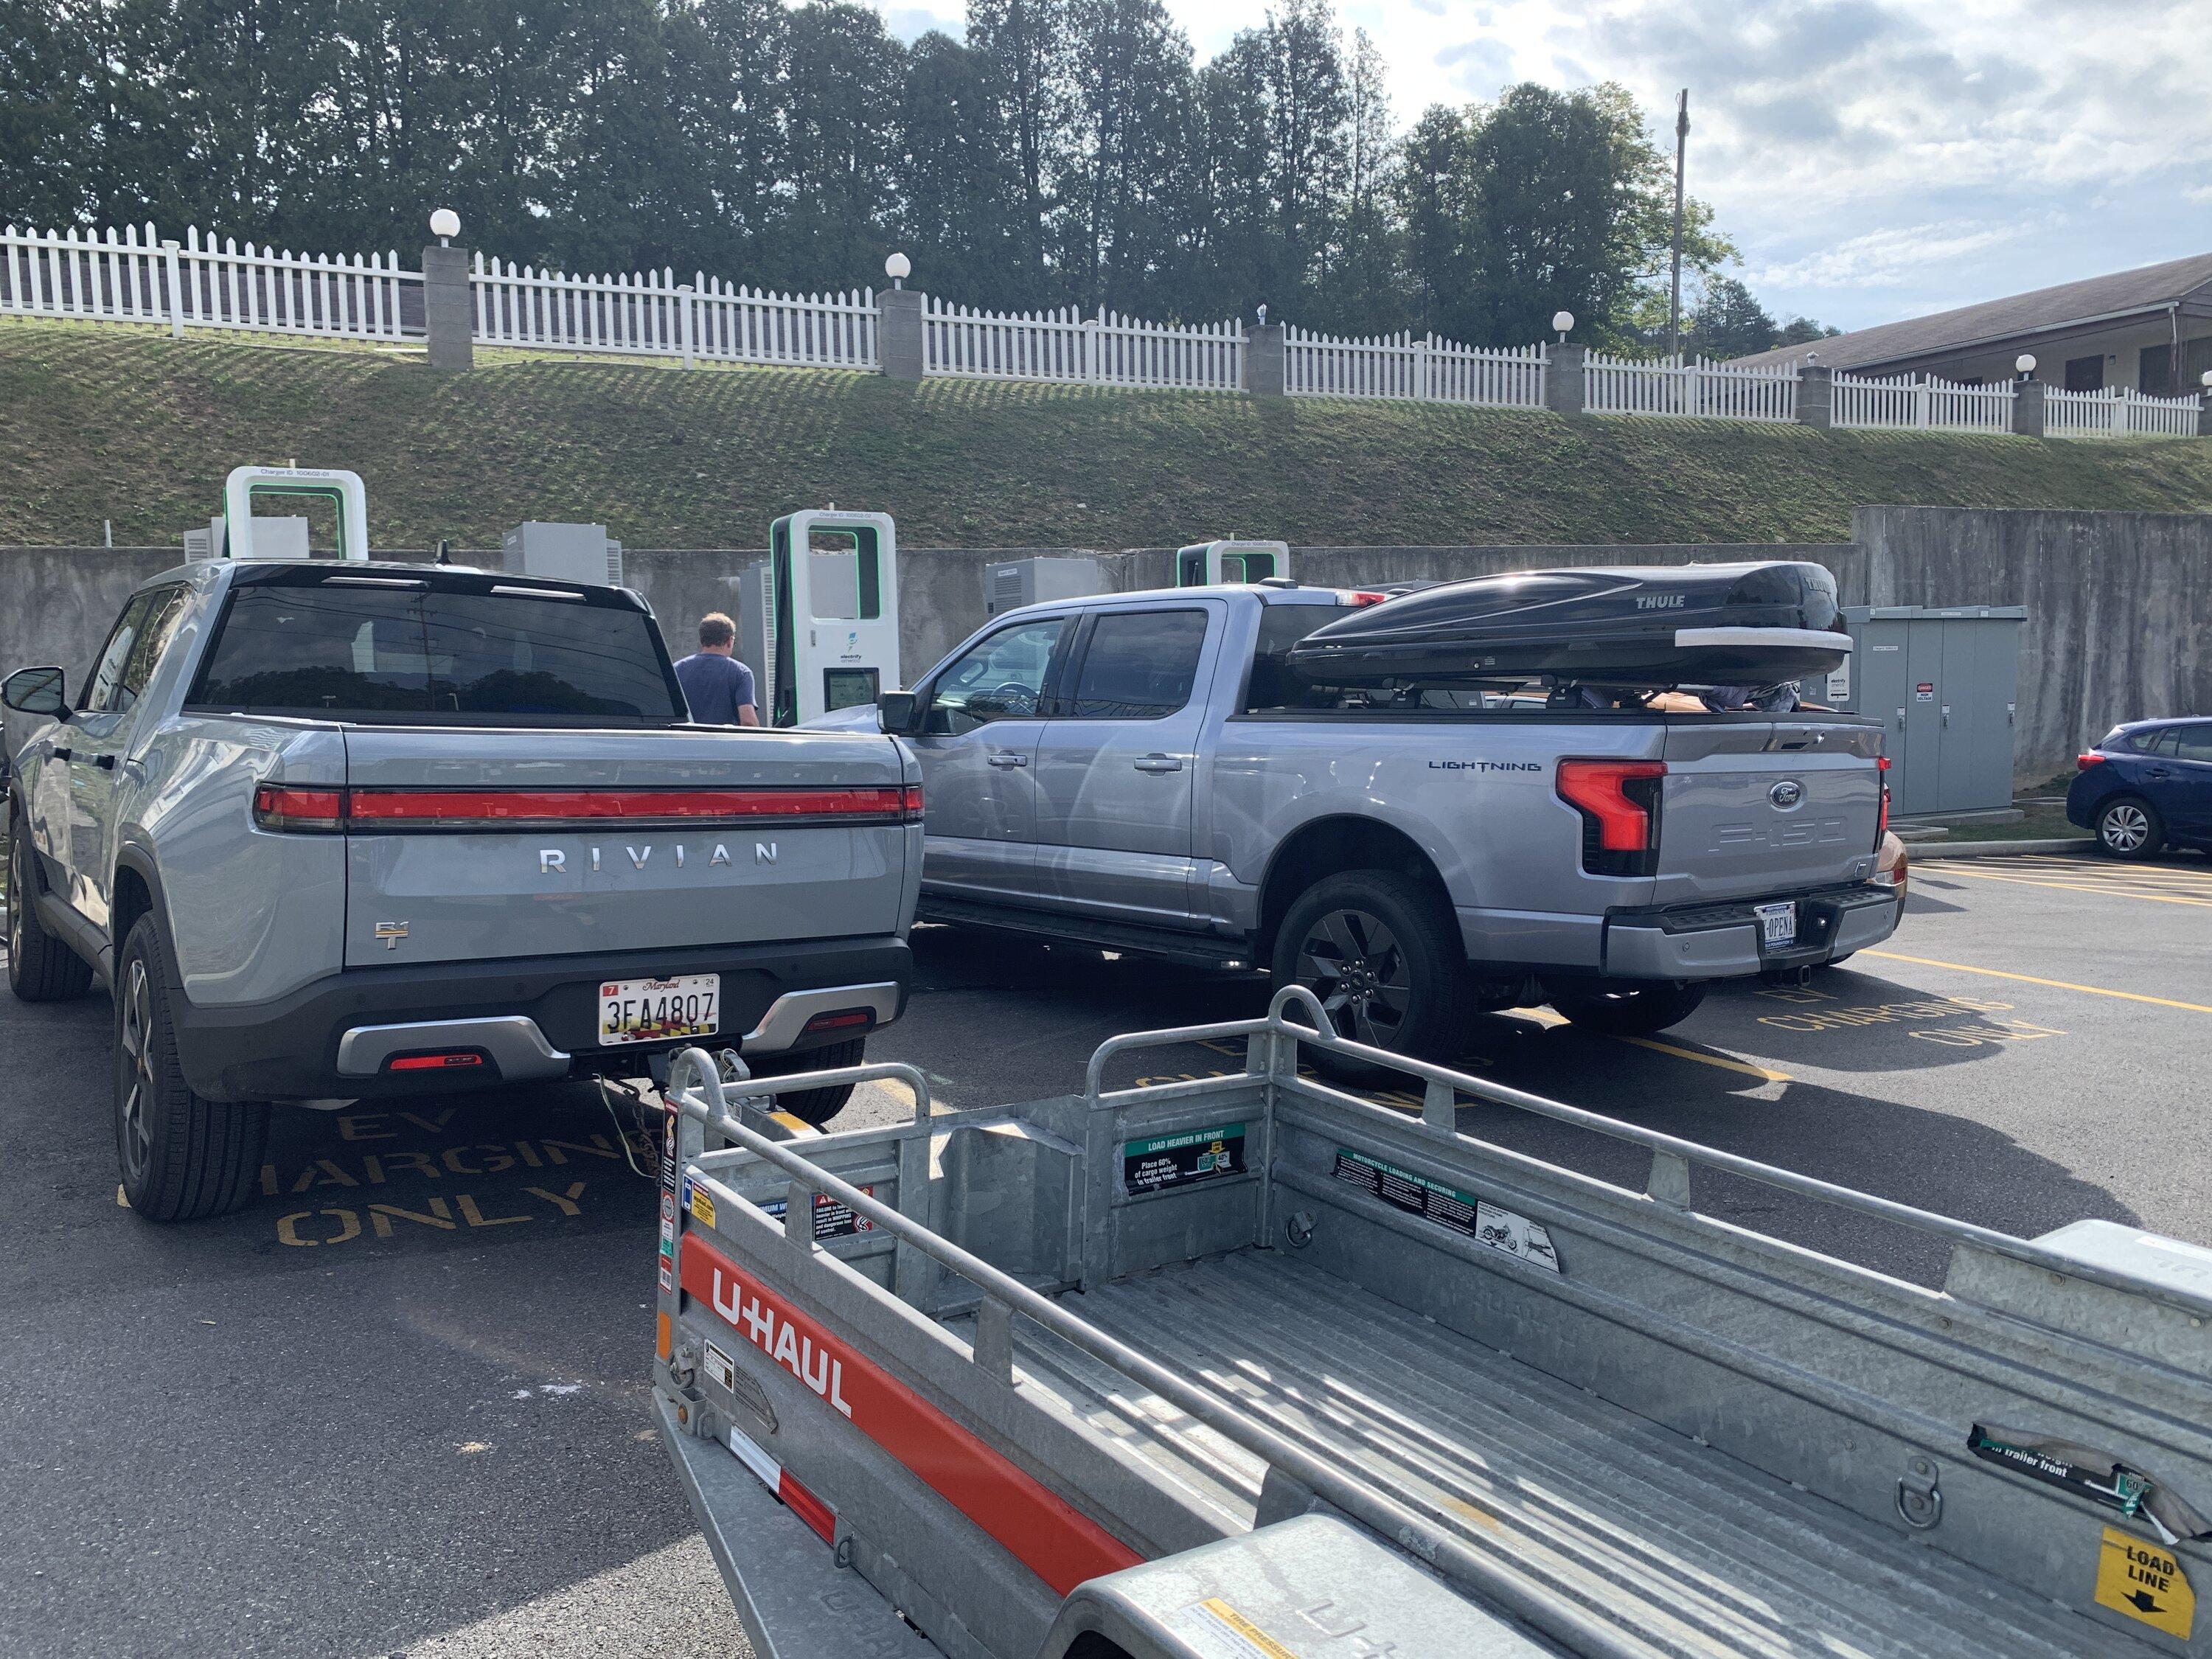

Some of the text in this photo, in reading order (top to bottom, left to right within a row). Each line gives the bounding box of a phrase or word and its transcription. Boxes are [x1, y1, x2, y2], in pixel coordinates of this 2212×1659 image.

[1636, 595, 1686, 609] THULE
[1429, 761, 1542, 772] LIGHTNING
[1779, 787, 1797, 802] Ford
[1708, 816, 1848, 852] F-150
[539, 842, 778, 874] RIVIAN
[608, 987, 614, 995] 7
[643, 980, 680, 992] Maryland
[1753, 988, 1839, 1003] EV
[608, 993, 714, 1030] 3FA4807
[1757, 997, 2015, 1030] CHARGING
[1908, 1020, 2069, 1046] ONLY
[338, 1107, 458, 1141] EV
[1148, 1130, 1224, 1151] LOAD HEAVIER IN FRONT
[1142, 1158, 1171, 1169] Place 60%
[1142, 1168, 1158, 1177] cargo
[1159, 1164, 1177, 1173] weight
[1353, 1153, 1388, 1171] MOTORCYCLE
[1389, 1166, 1413, 1181] LOADING
[1414, 1177, 1426, 1187] AND
[1427, 1181, 1456, 1197] SECURING
[1144, 1176, 1162, 1184] trailer
[1163, 1172, 1177, 1182] front
[276, 1182, 585, 1246] ONLY
[713, 1267, 851, 1418] U-HAUL
[2005, 1448, 2038, 1466] trailer
[2040, 1460, 2067, 1477] front
[2127, 1545, 2174, 1576] LOAD
[2128, 1565, 2170, 1593] LINE
[1197, 1612, 1207, 1620] NOT
[1230, 1613, 1250, 1628] TIRE
[1249, 1628, 1294, 1659] PRESSUR
